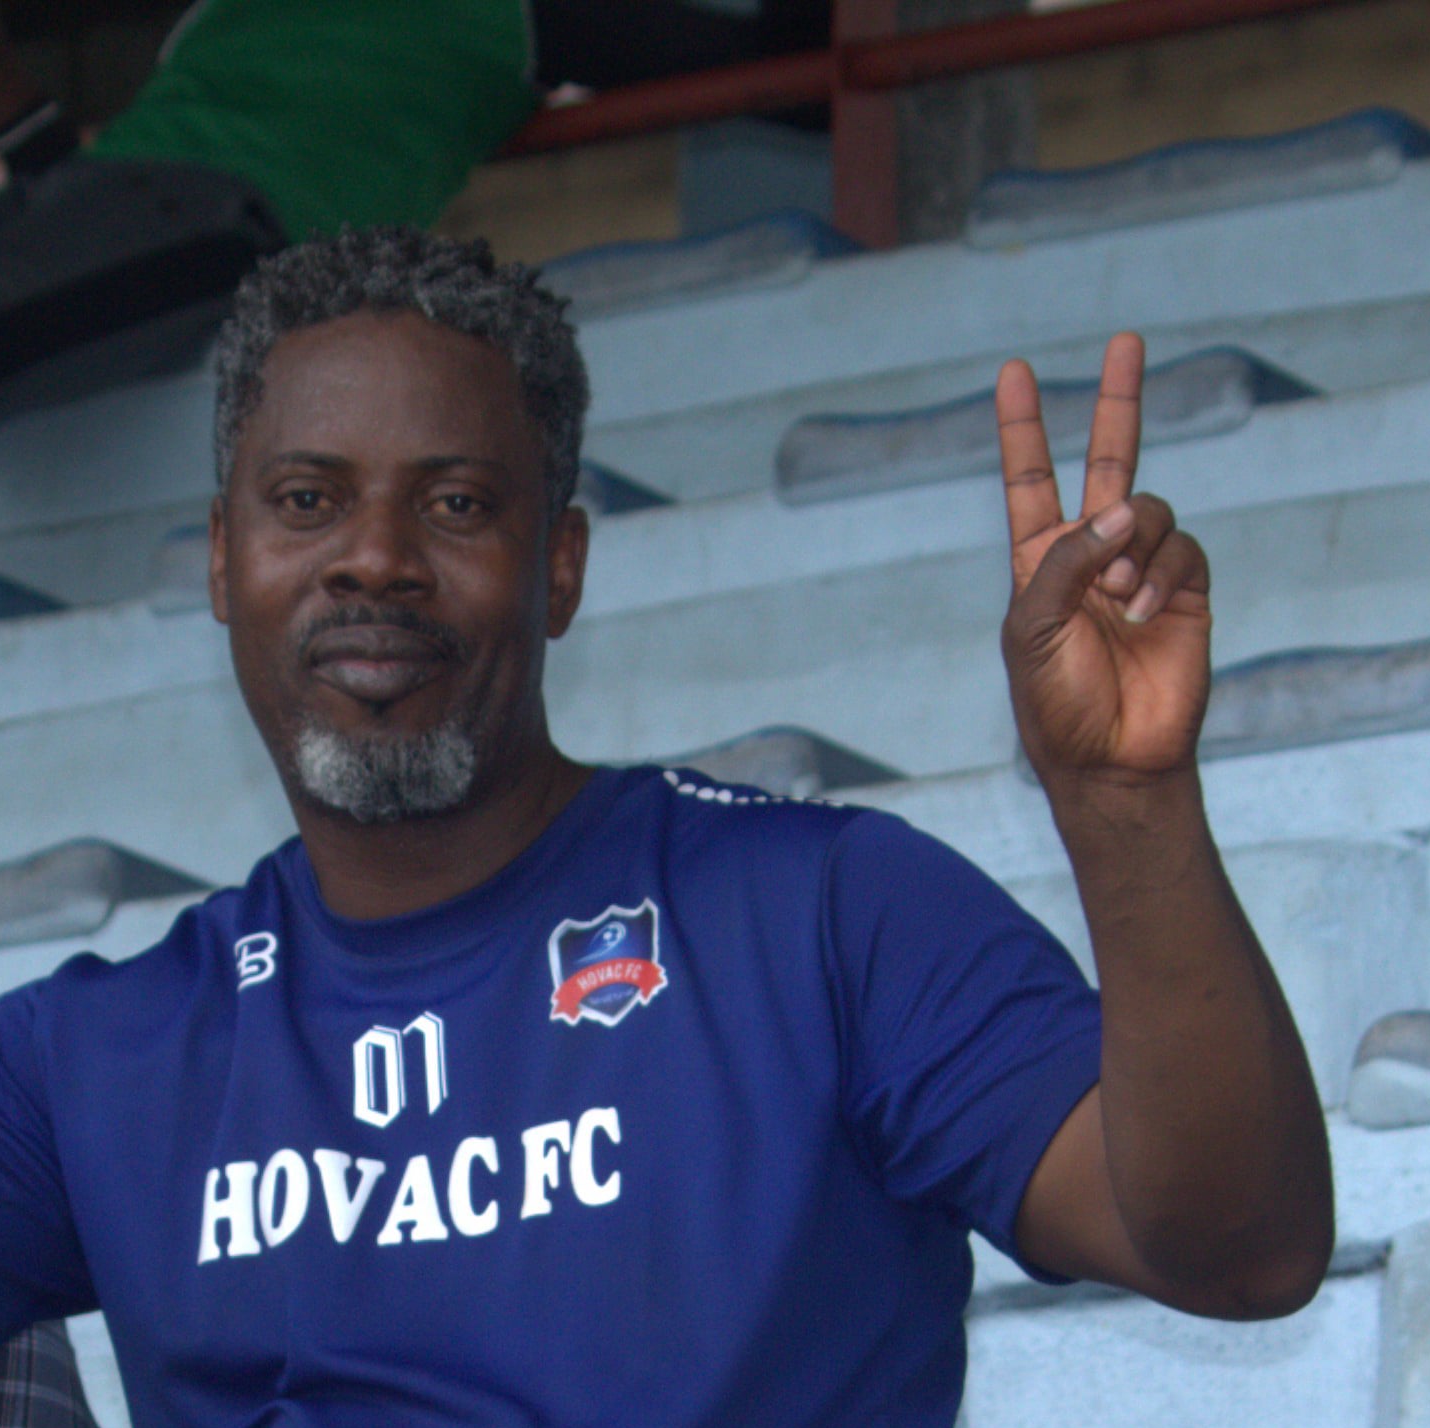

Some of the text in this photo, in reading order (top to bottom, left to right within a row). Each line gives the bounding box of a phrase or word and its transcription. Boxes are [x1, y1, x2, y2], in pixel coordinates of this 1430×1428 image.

[577, 963, 623, 992] HOVAC
[353, 1011, 447, 1128] 01
[197, 1107, 621, 1265] HOVAC FC
